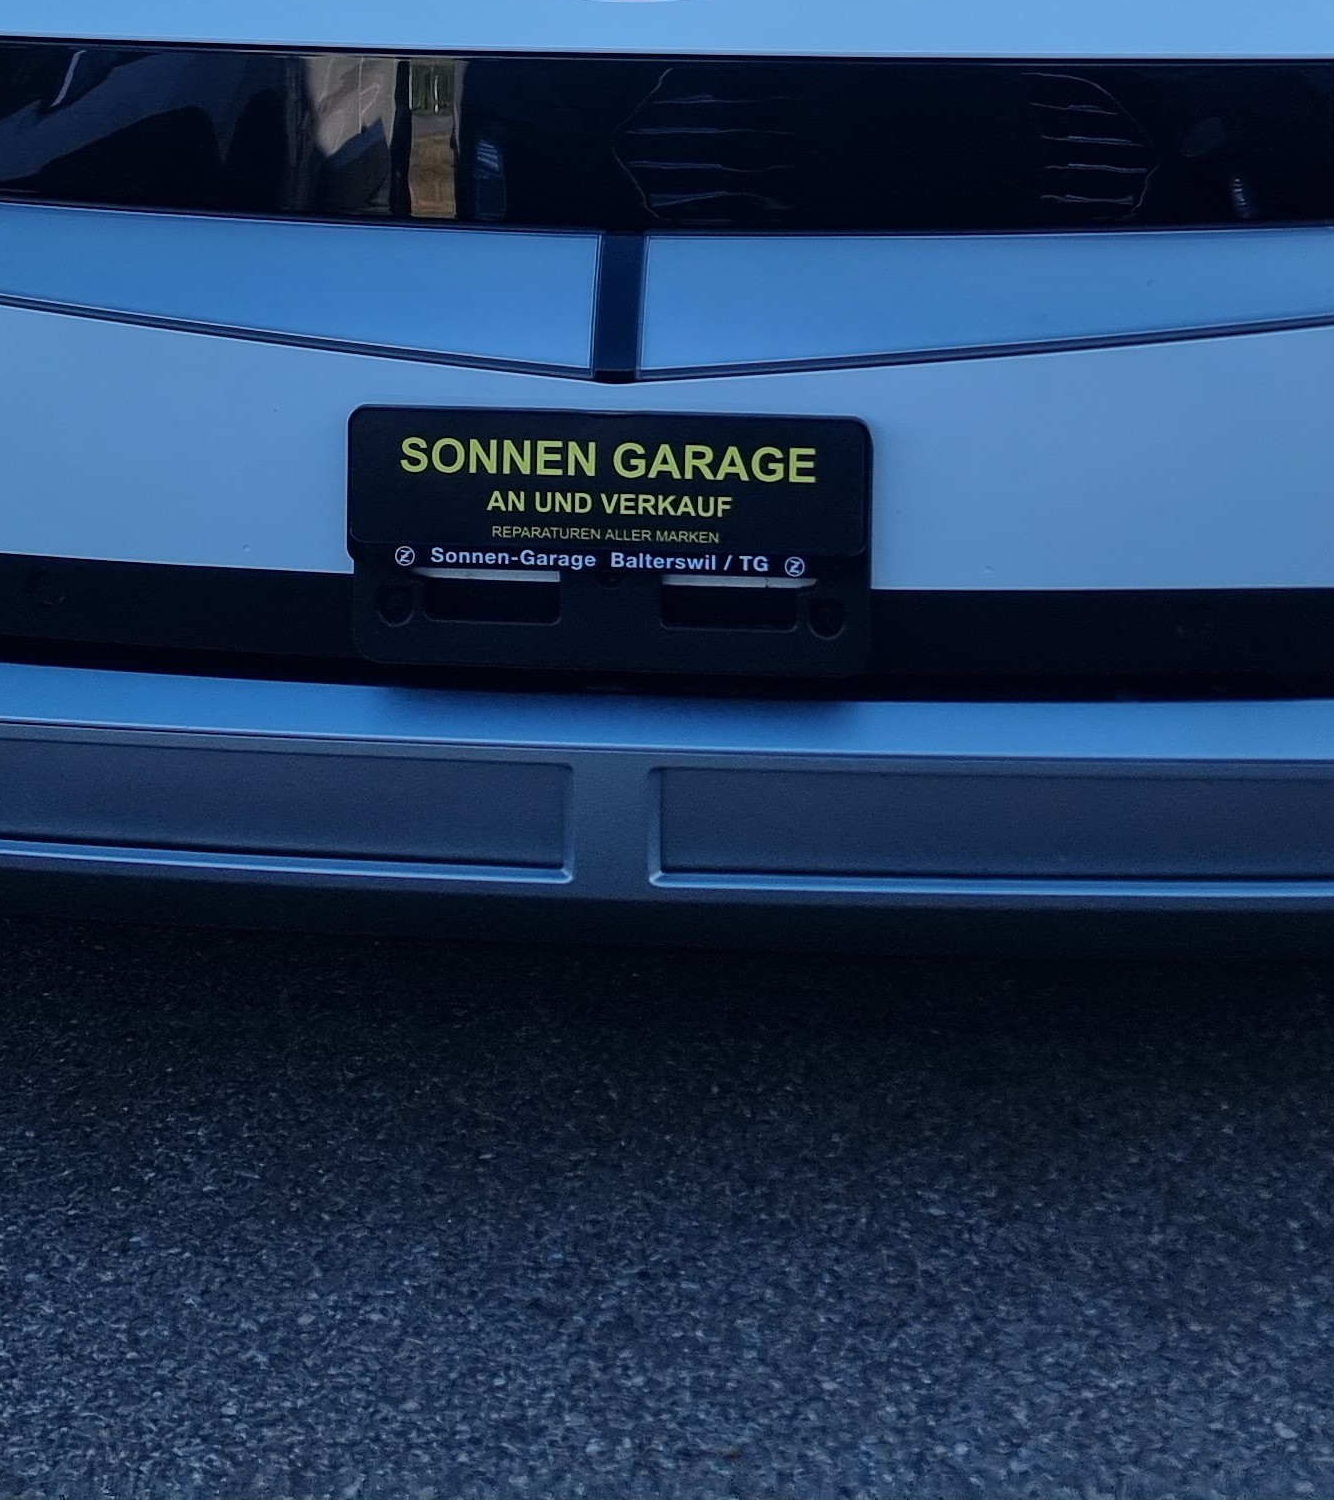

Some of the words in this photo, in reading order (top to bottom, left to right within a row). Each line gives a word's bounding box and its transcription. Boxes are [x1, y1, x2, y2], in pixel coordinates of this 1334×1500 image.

[400, 436, 597, 477] SONNEN
[613, 442, 817, 484] GARAGE
[486, 490, 526, 512] AN
[534, 491, 593, 514] UND
[600, 493, 734, 518] VERKAUF
[491, 525, 601, 540] REPARATUREN
[604, 528, 653, 542] ALLER
[655, 530, 720, 544] MARKEN
[430, 546, 597, 571] Sonnen-Garage
[610, 551, 716, 571] Balterswil
[738, 555, 769, 572] TG
